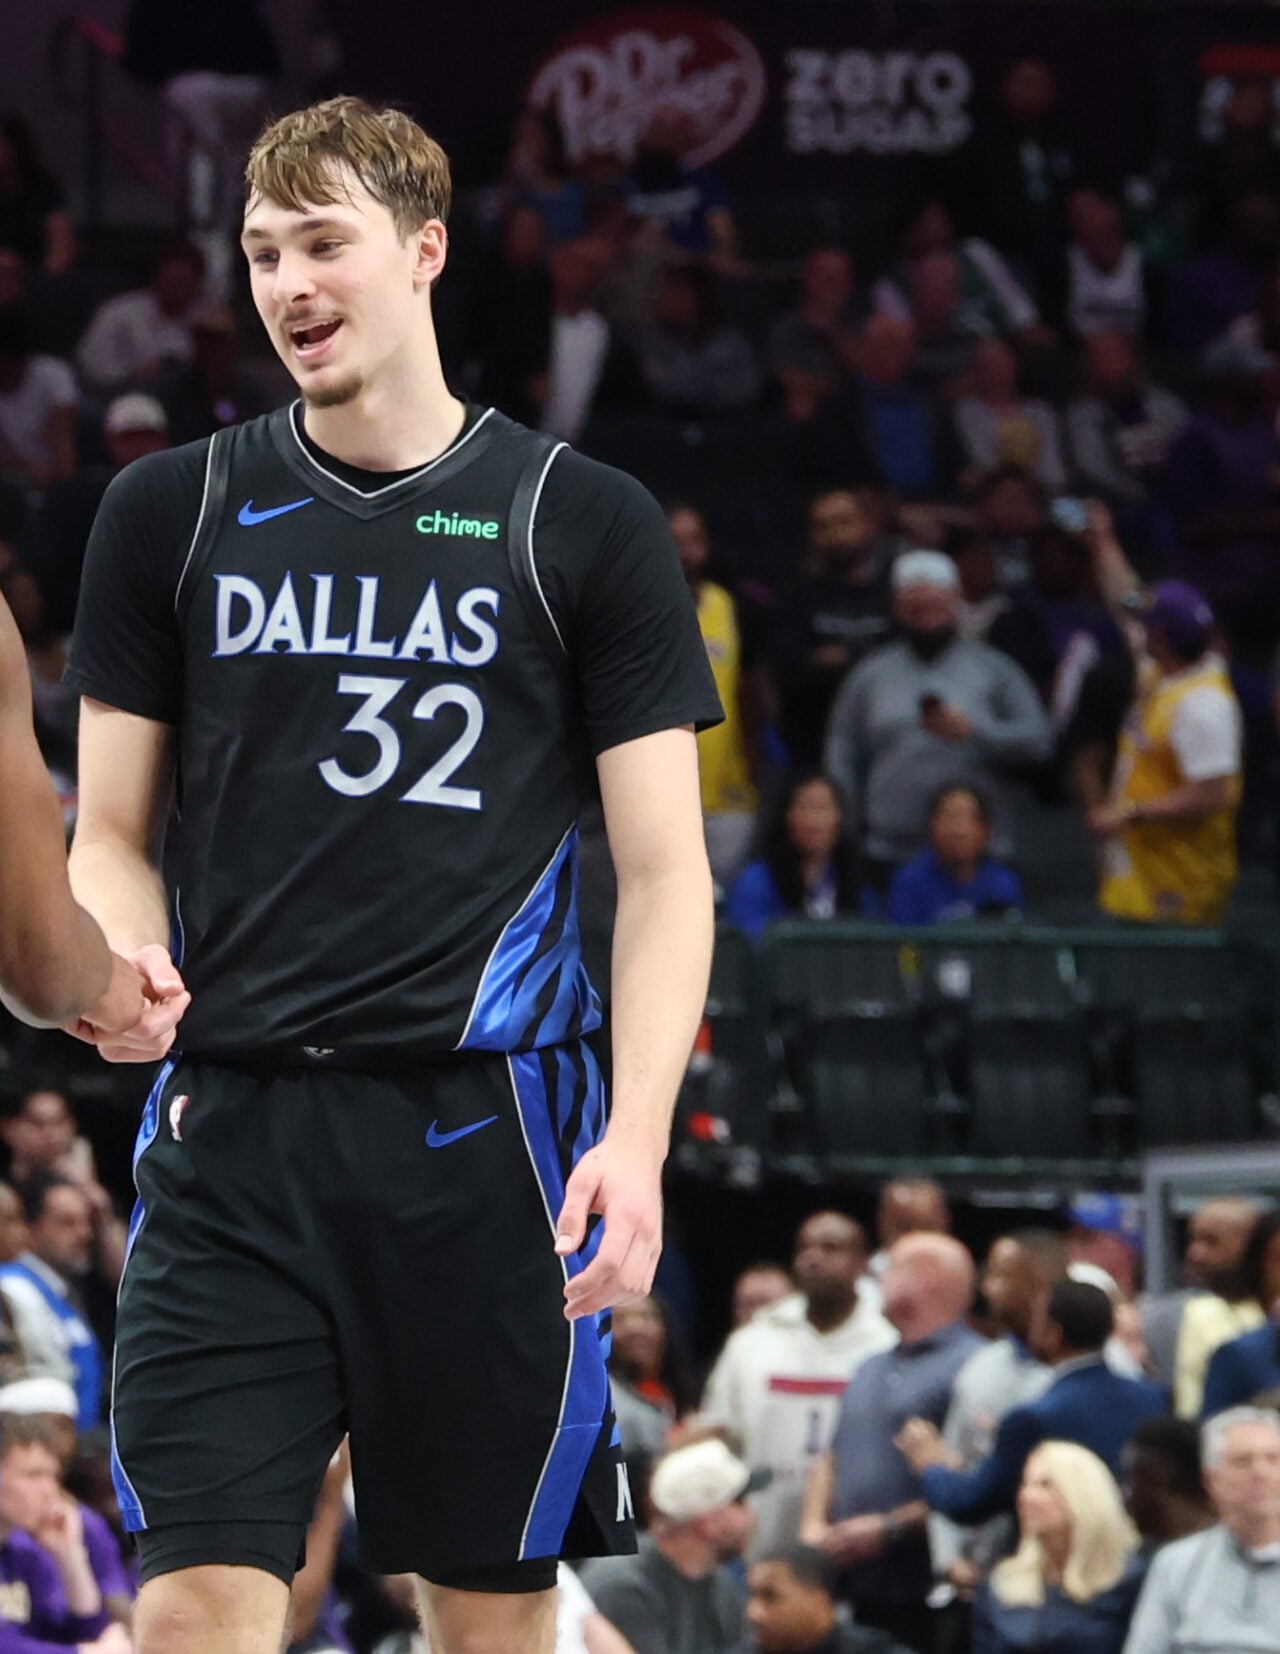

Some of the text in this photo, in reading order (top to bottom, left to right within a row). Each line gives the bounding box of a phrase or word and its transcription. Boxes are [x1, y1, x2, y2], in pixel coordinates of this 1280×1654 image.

[786, 49, 972, 106] zero
[786, 104, 972, 153] SUGAR
[416, 510, 499, 540] chime
[212, 570, 501, 668] DALLAS
[317, 672, 485, 811] 32
